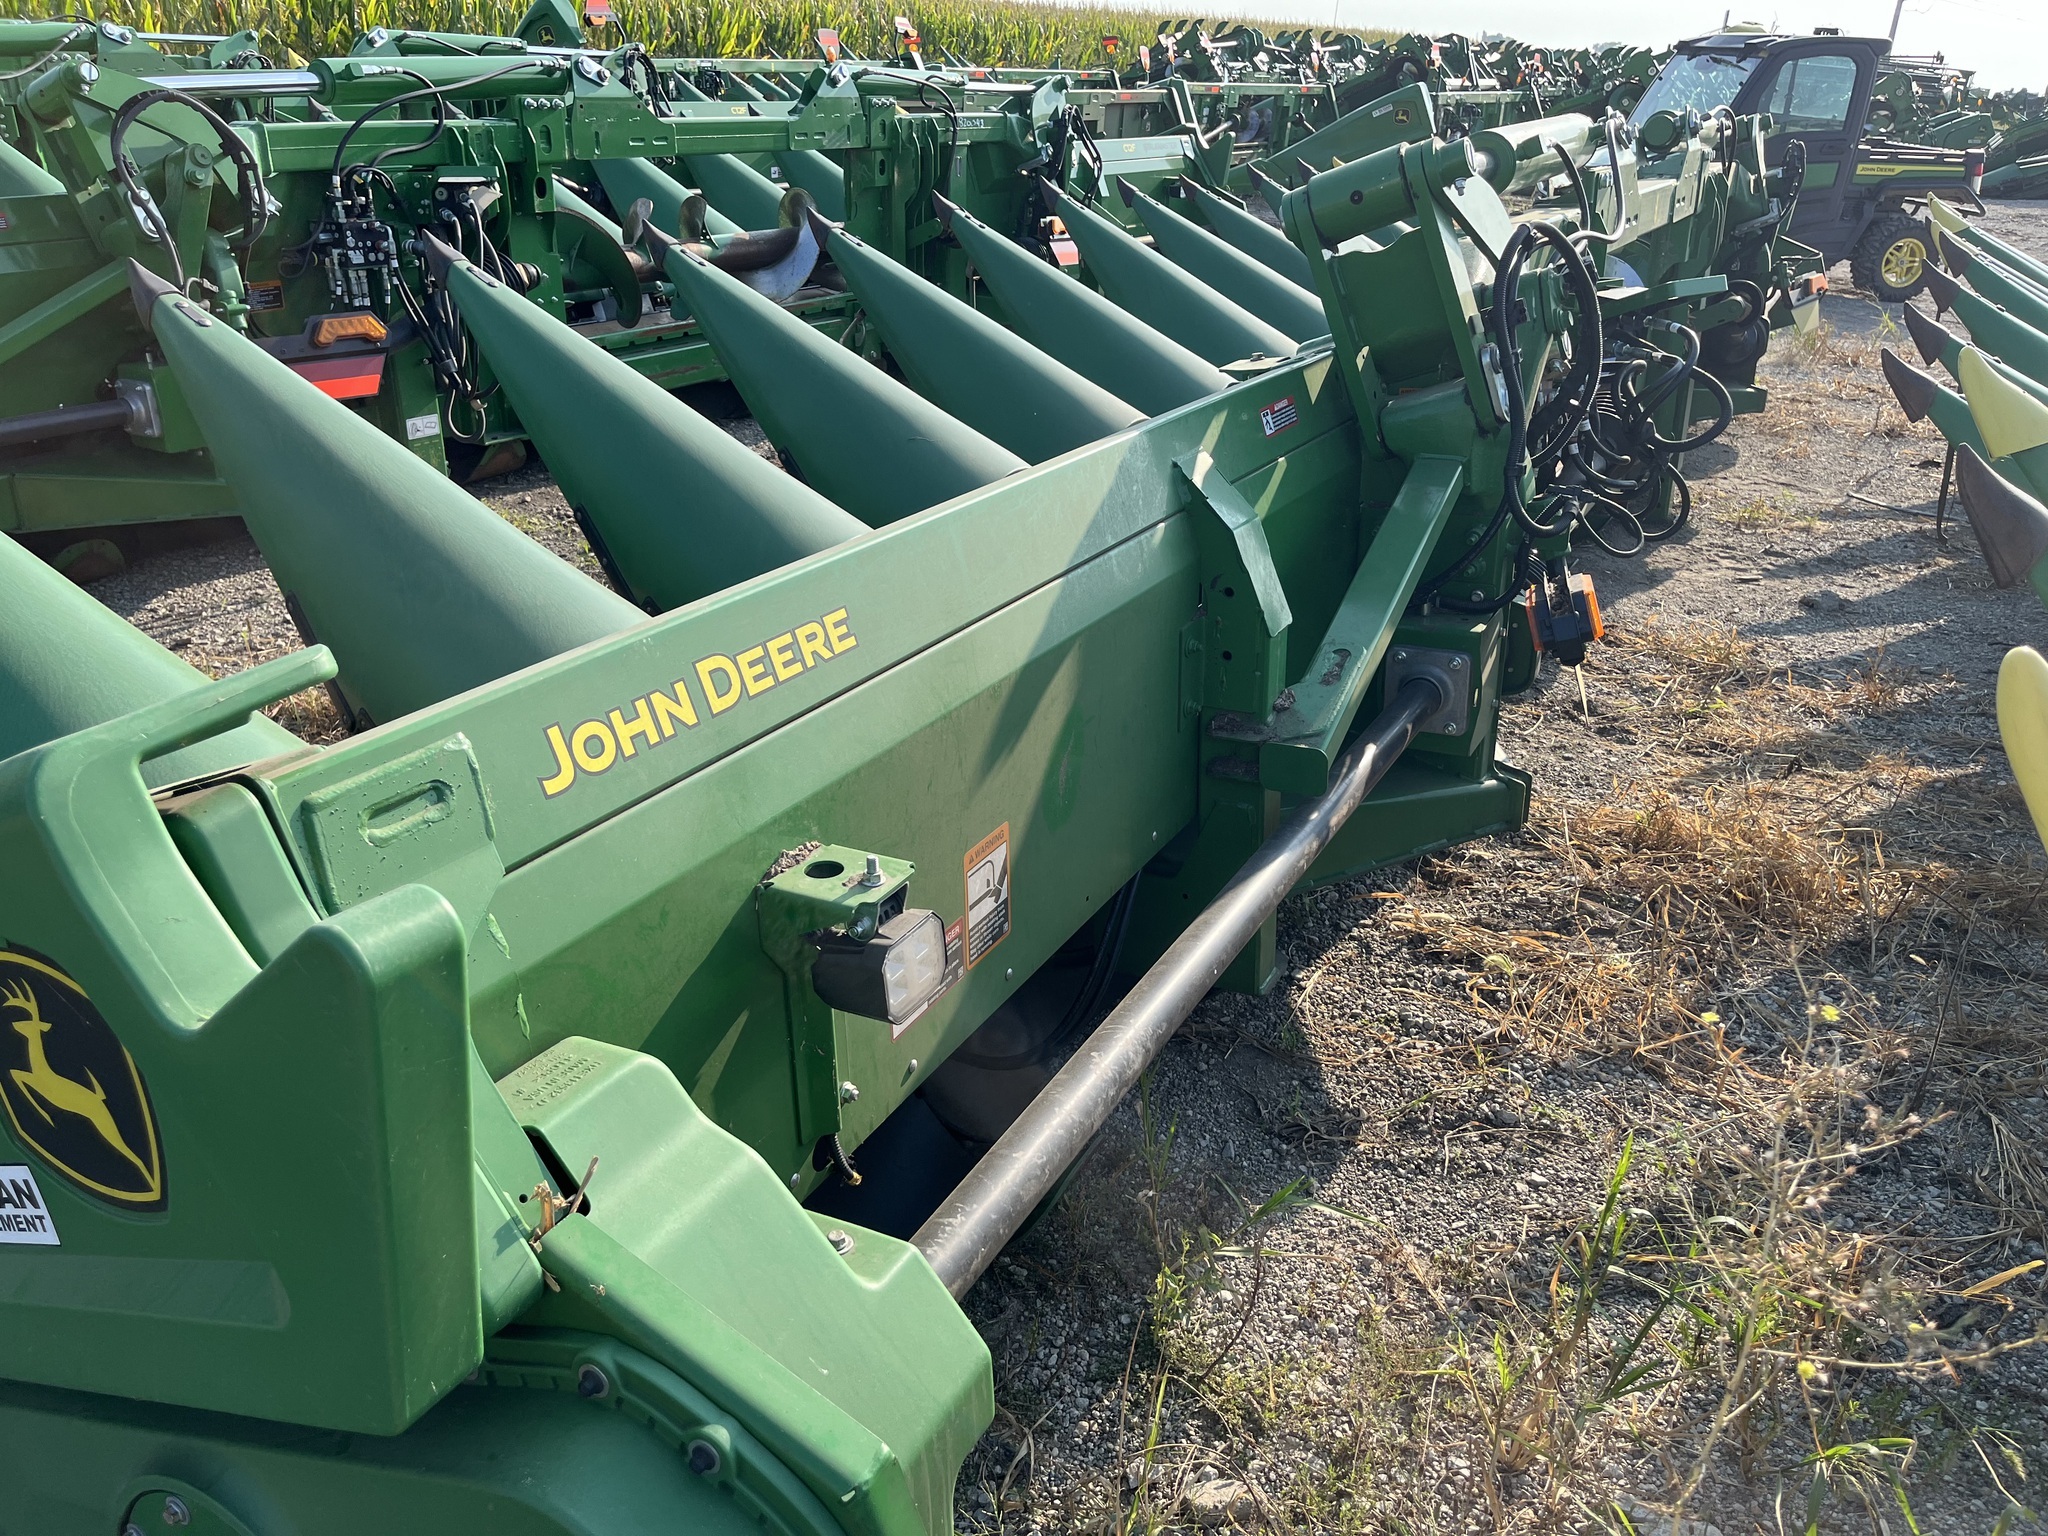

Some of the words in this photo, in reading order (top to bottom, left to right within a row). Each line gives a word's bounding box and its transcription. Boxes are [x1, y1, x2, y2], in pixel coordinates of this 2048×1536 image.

[538, 677, 701, 799] JOHN
[692, 605, 860, 718] DEERE
[974, 829, 1005, 859] WARNING
[0, 1214, 47, 1233] MENT
